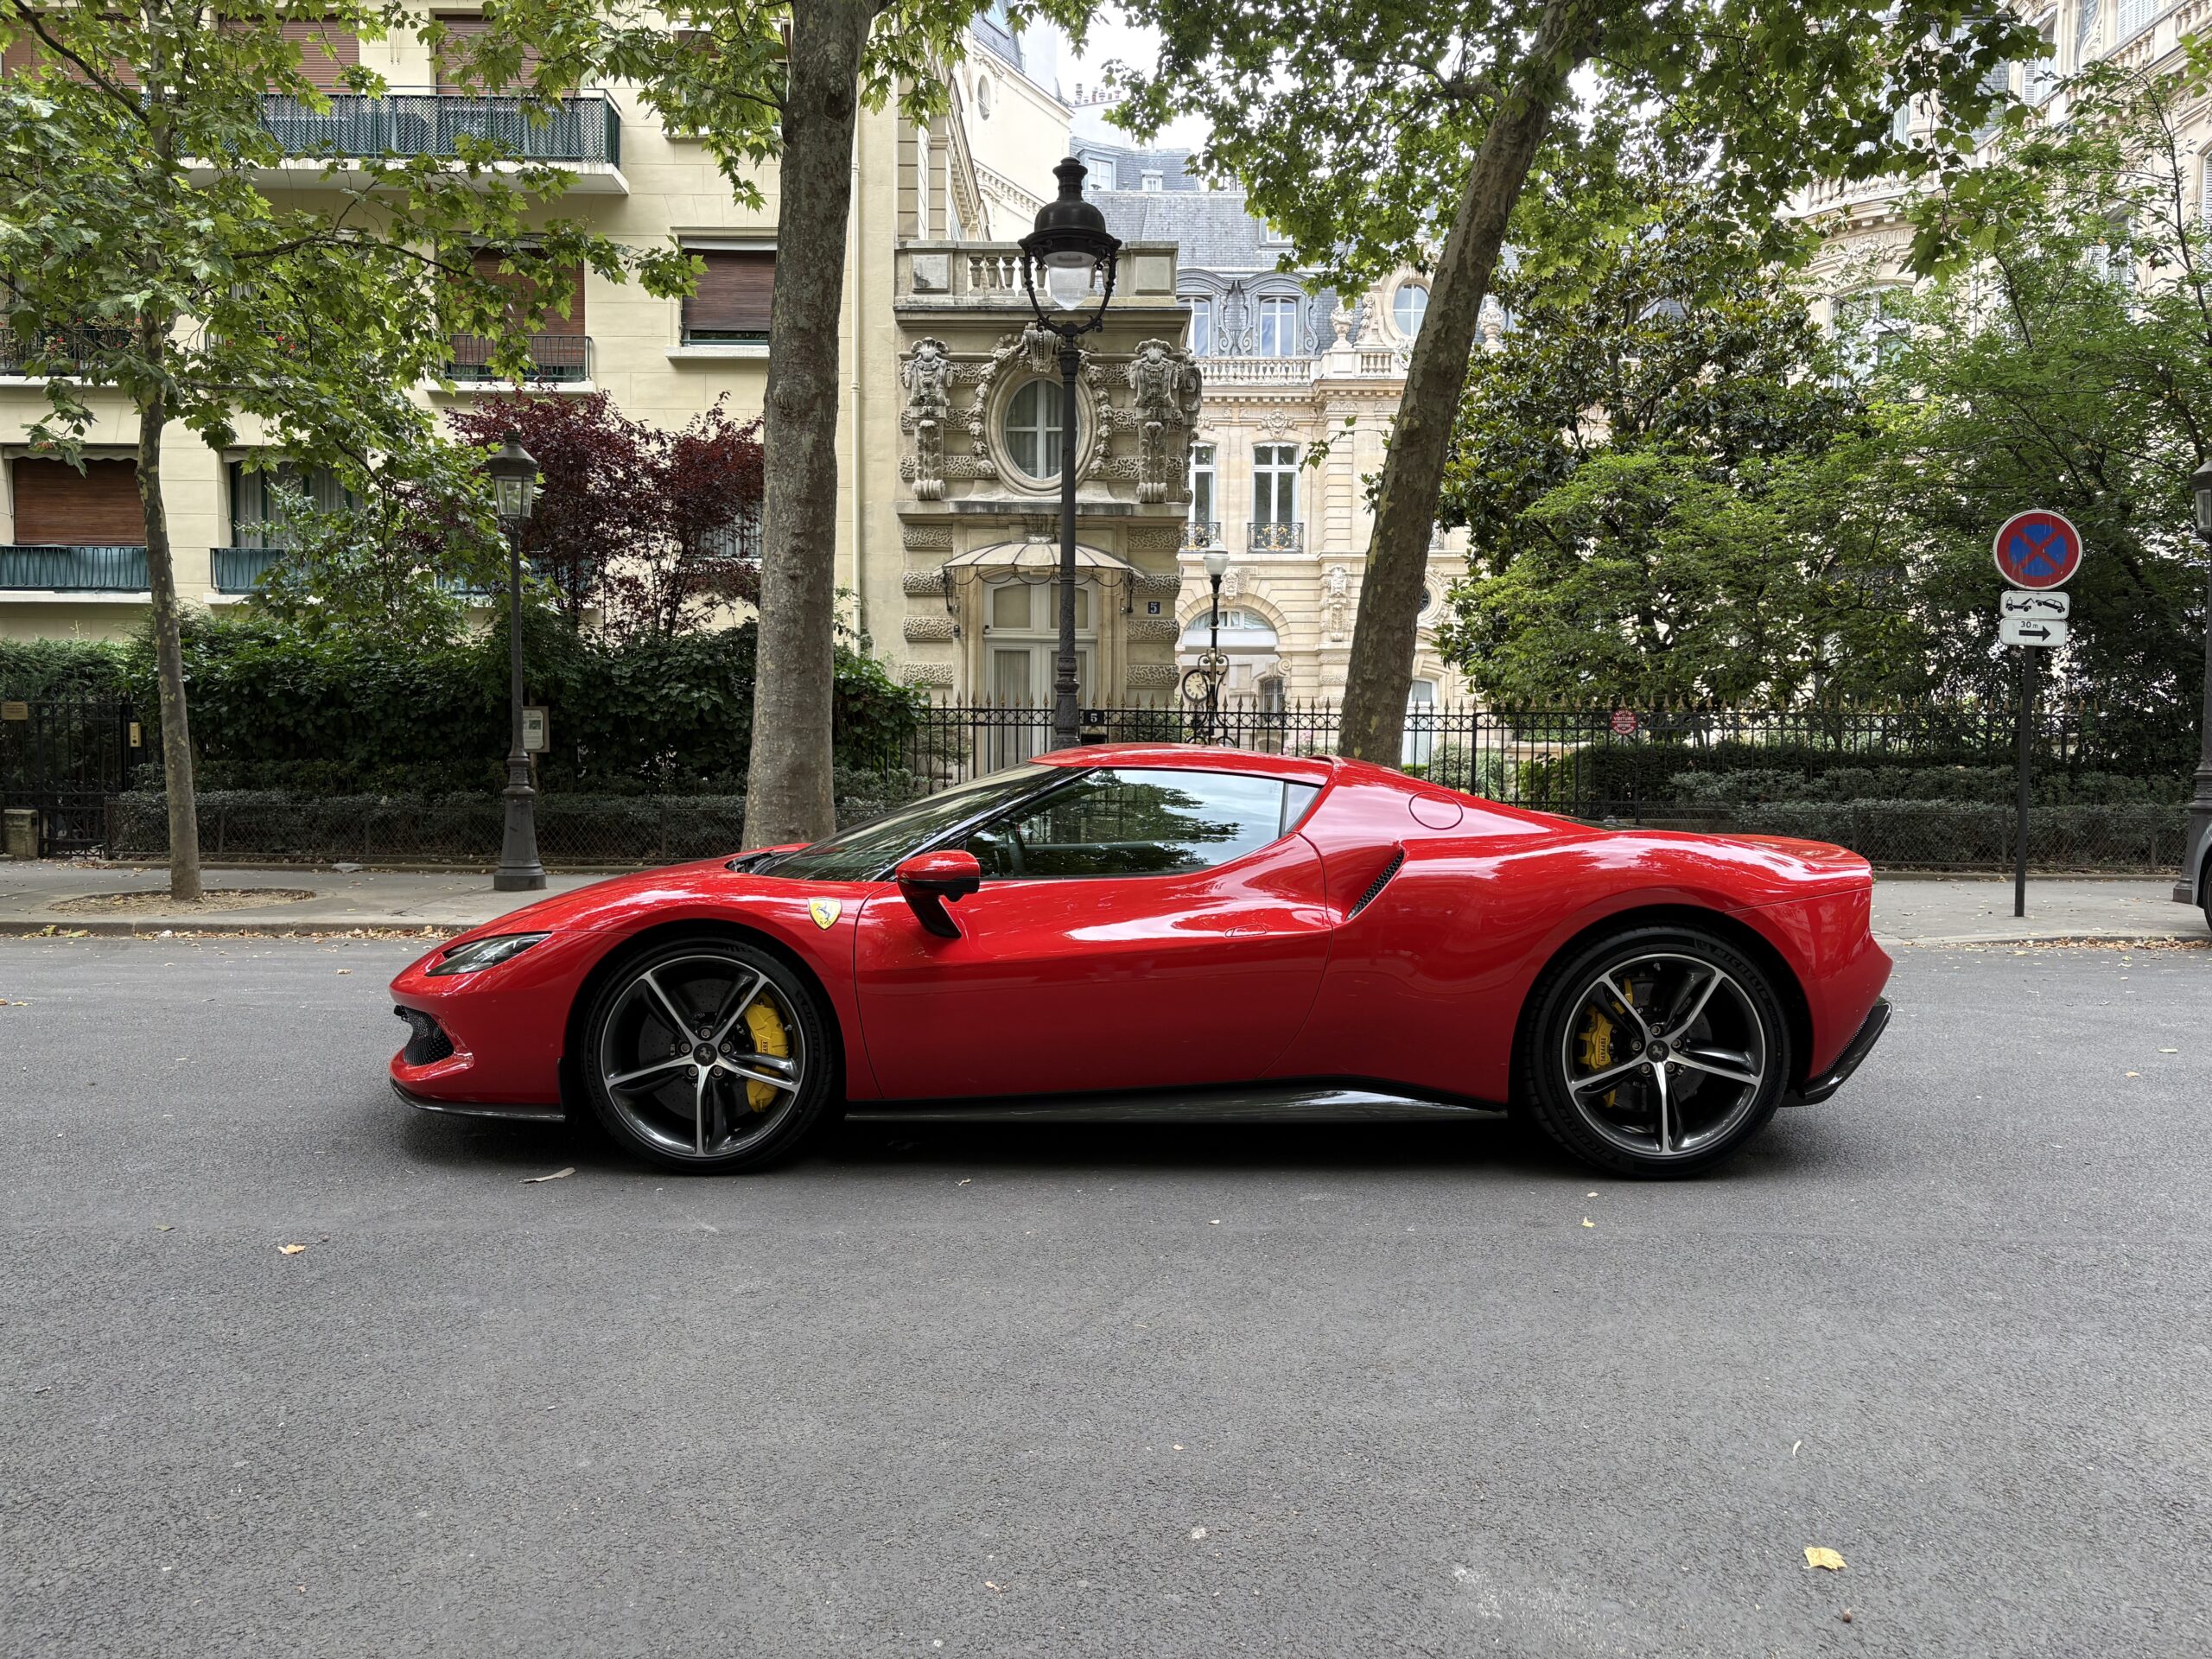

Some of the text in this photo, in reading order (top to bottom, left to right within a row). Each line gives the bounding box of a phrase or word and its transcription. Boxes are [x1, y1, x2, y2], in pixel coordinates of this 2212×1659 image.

[1150, 602, 1157, 613] 5
[1090, 713, 1097, 723] 5
[1713, 947, 1770, 1001] MICHELIN
